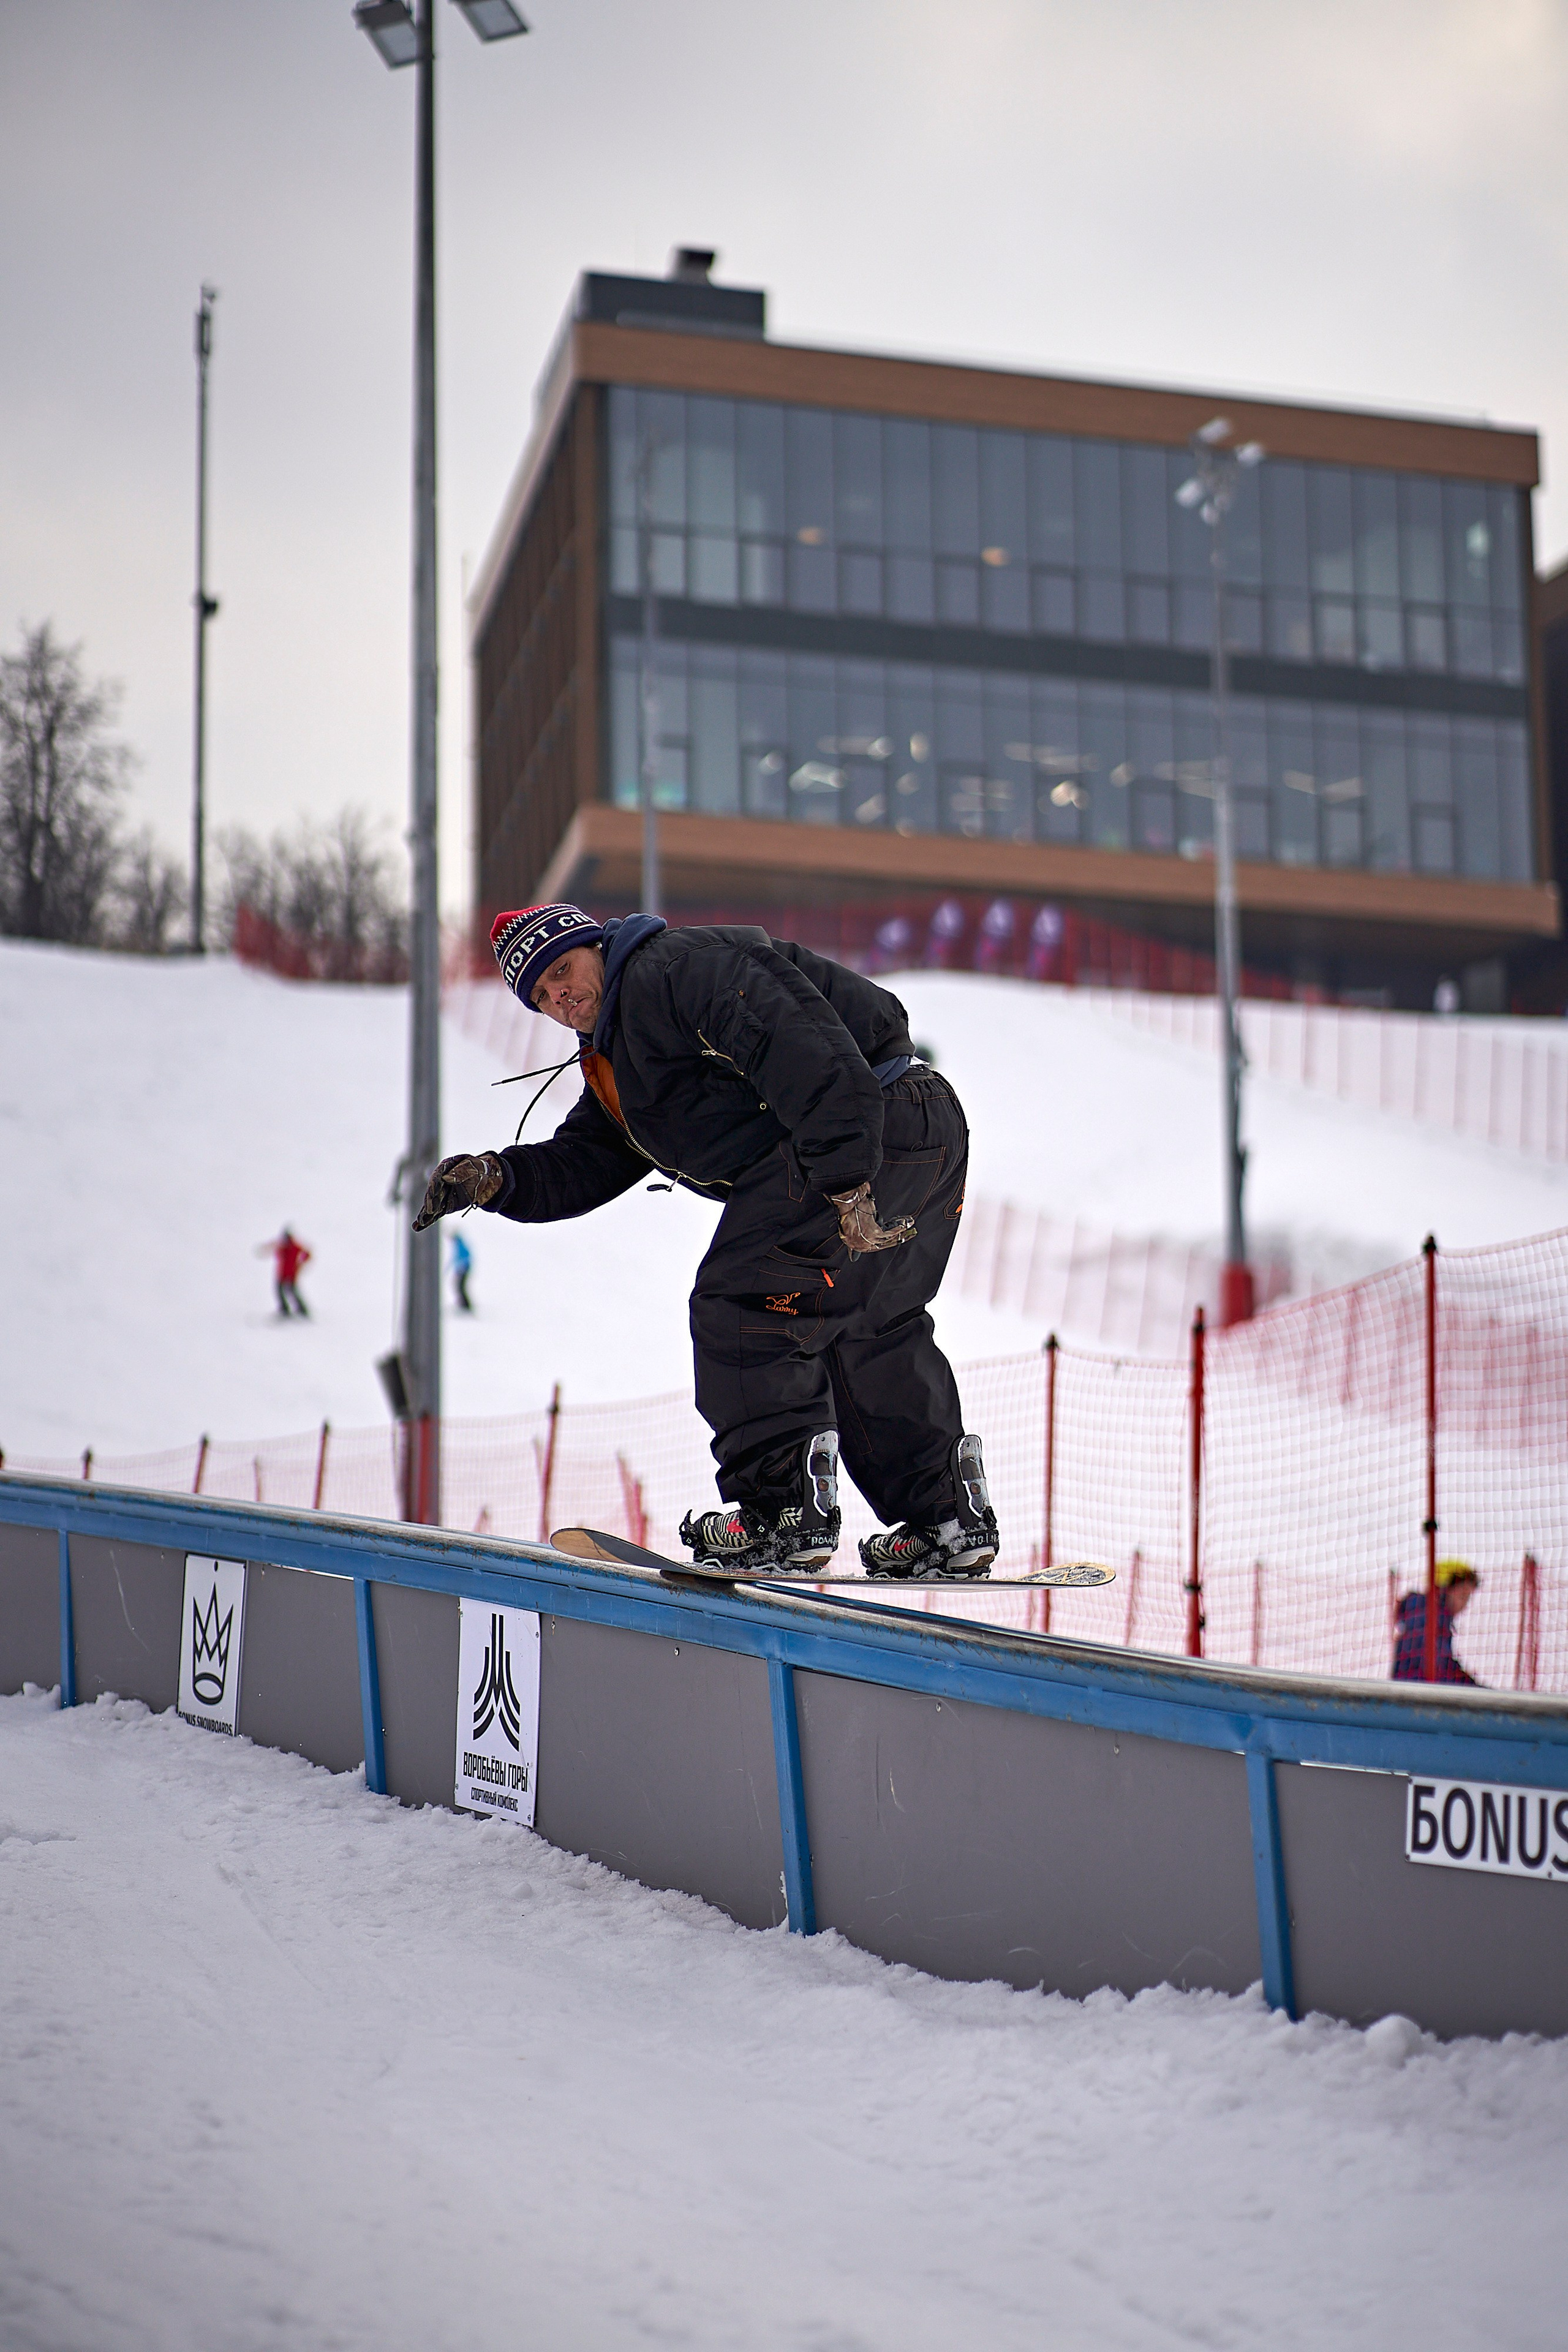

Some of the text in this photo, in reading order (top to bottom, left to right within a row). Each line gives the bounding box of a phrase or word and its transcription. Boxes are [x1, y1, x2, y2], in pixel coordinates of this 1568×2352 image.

[463, 1752, 528, 1793] ВОРОБЬЁВЫ ГОРЫ
[471, 1787, 518, 1812] СПОРТИВНЫЙ КОМПЛЕКС
